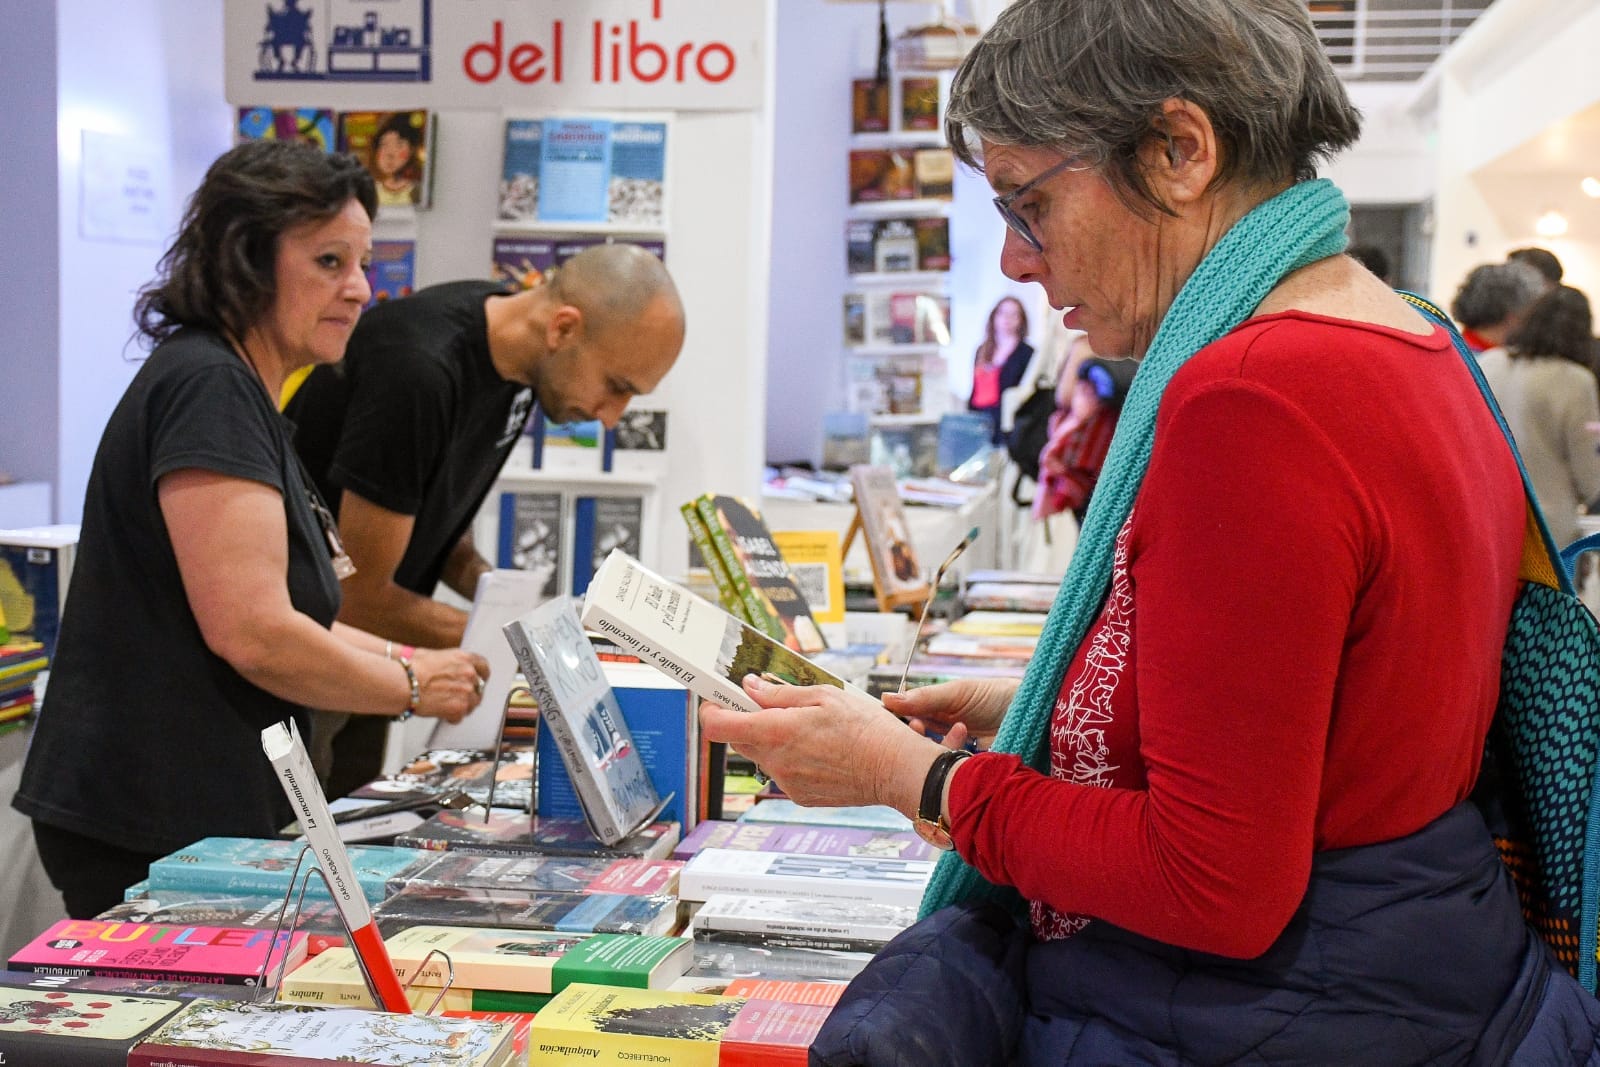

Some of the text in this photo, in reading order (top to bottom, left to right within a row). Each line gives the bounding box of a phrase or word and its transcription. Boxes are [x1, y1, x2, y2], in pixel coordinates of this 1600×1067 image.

[463, 20, 736, 84] del libro
[598, 618, 696, 683] El baile y el incendio
[535, 682, 561, 722] KING
[283, 768, 318, 830] La encomienda
[322, 848, 337, 876] ROBAYO
[55, 921, 289, 949] BUTLER
[34, 966, 90, 977] JUDITH BUTLER
[289, 990, 325, 1000] Hambre
[340, 993, 361, 1001] FANTE
[539, 1043, 601, 1058] Aniquilación
[617, 1051, 671, 1063] HOUELLEBECQ
